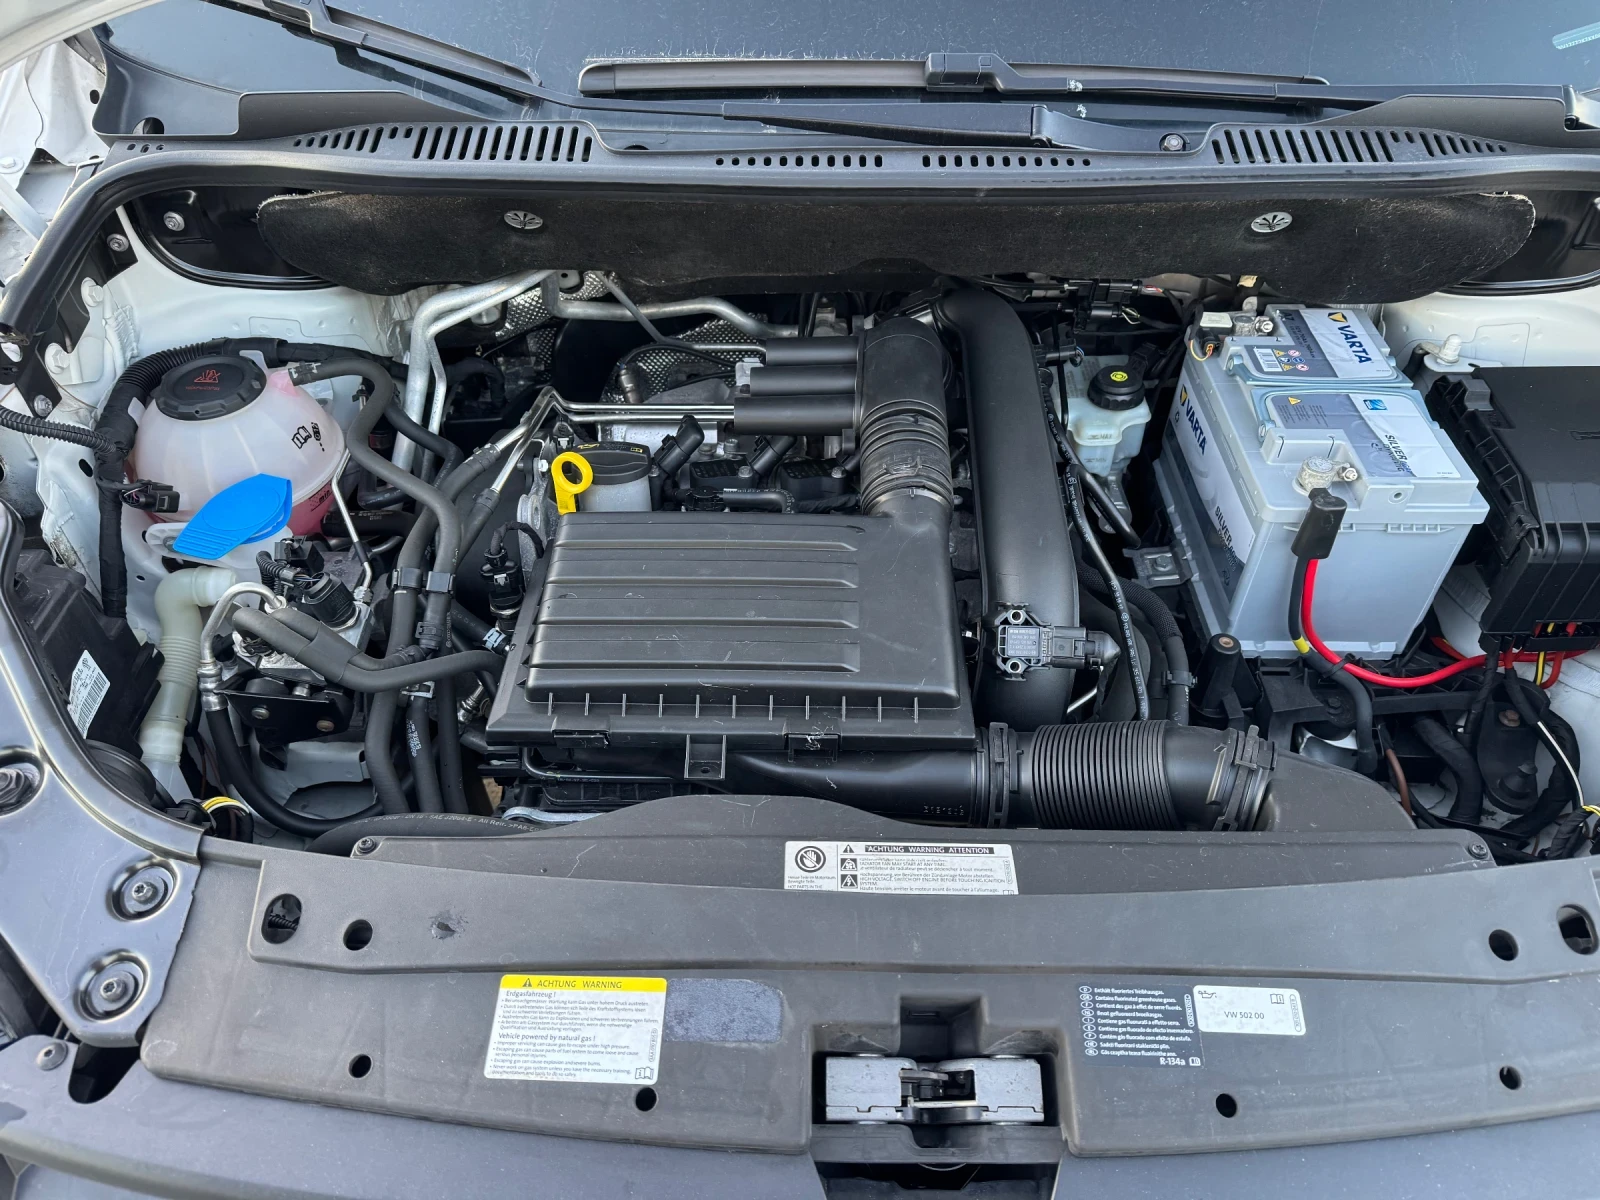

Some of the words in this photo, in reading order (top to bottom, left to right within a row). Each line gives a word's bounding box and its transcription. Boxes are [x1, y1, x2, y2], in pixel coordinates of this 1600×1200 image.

[1338, 324, 1372, 365] VARTA
[1186, 400, 1207, 455] VARTA
[1385, 434, 1407, 461] SILVER
[1215, 506, 1232, 546] SILVER
[537, 980, 576, 988] ACHTUNG
[582, 980, 622, 988] WARNING
[549, 1034, 556, 1042] by
[1159, 1057, 1186, 1065] R-134a
